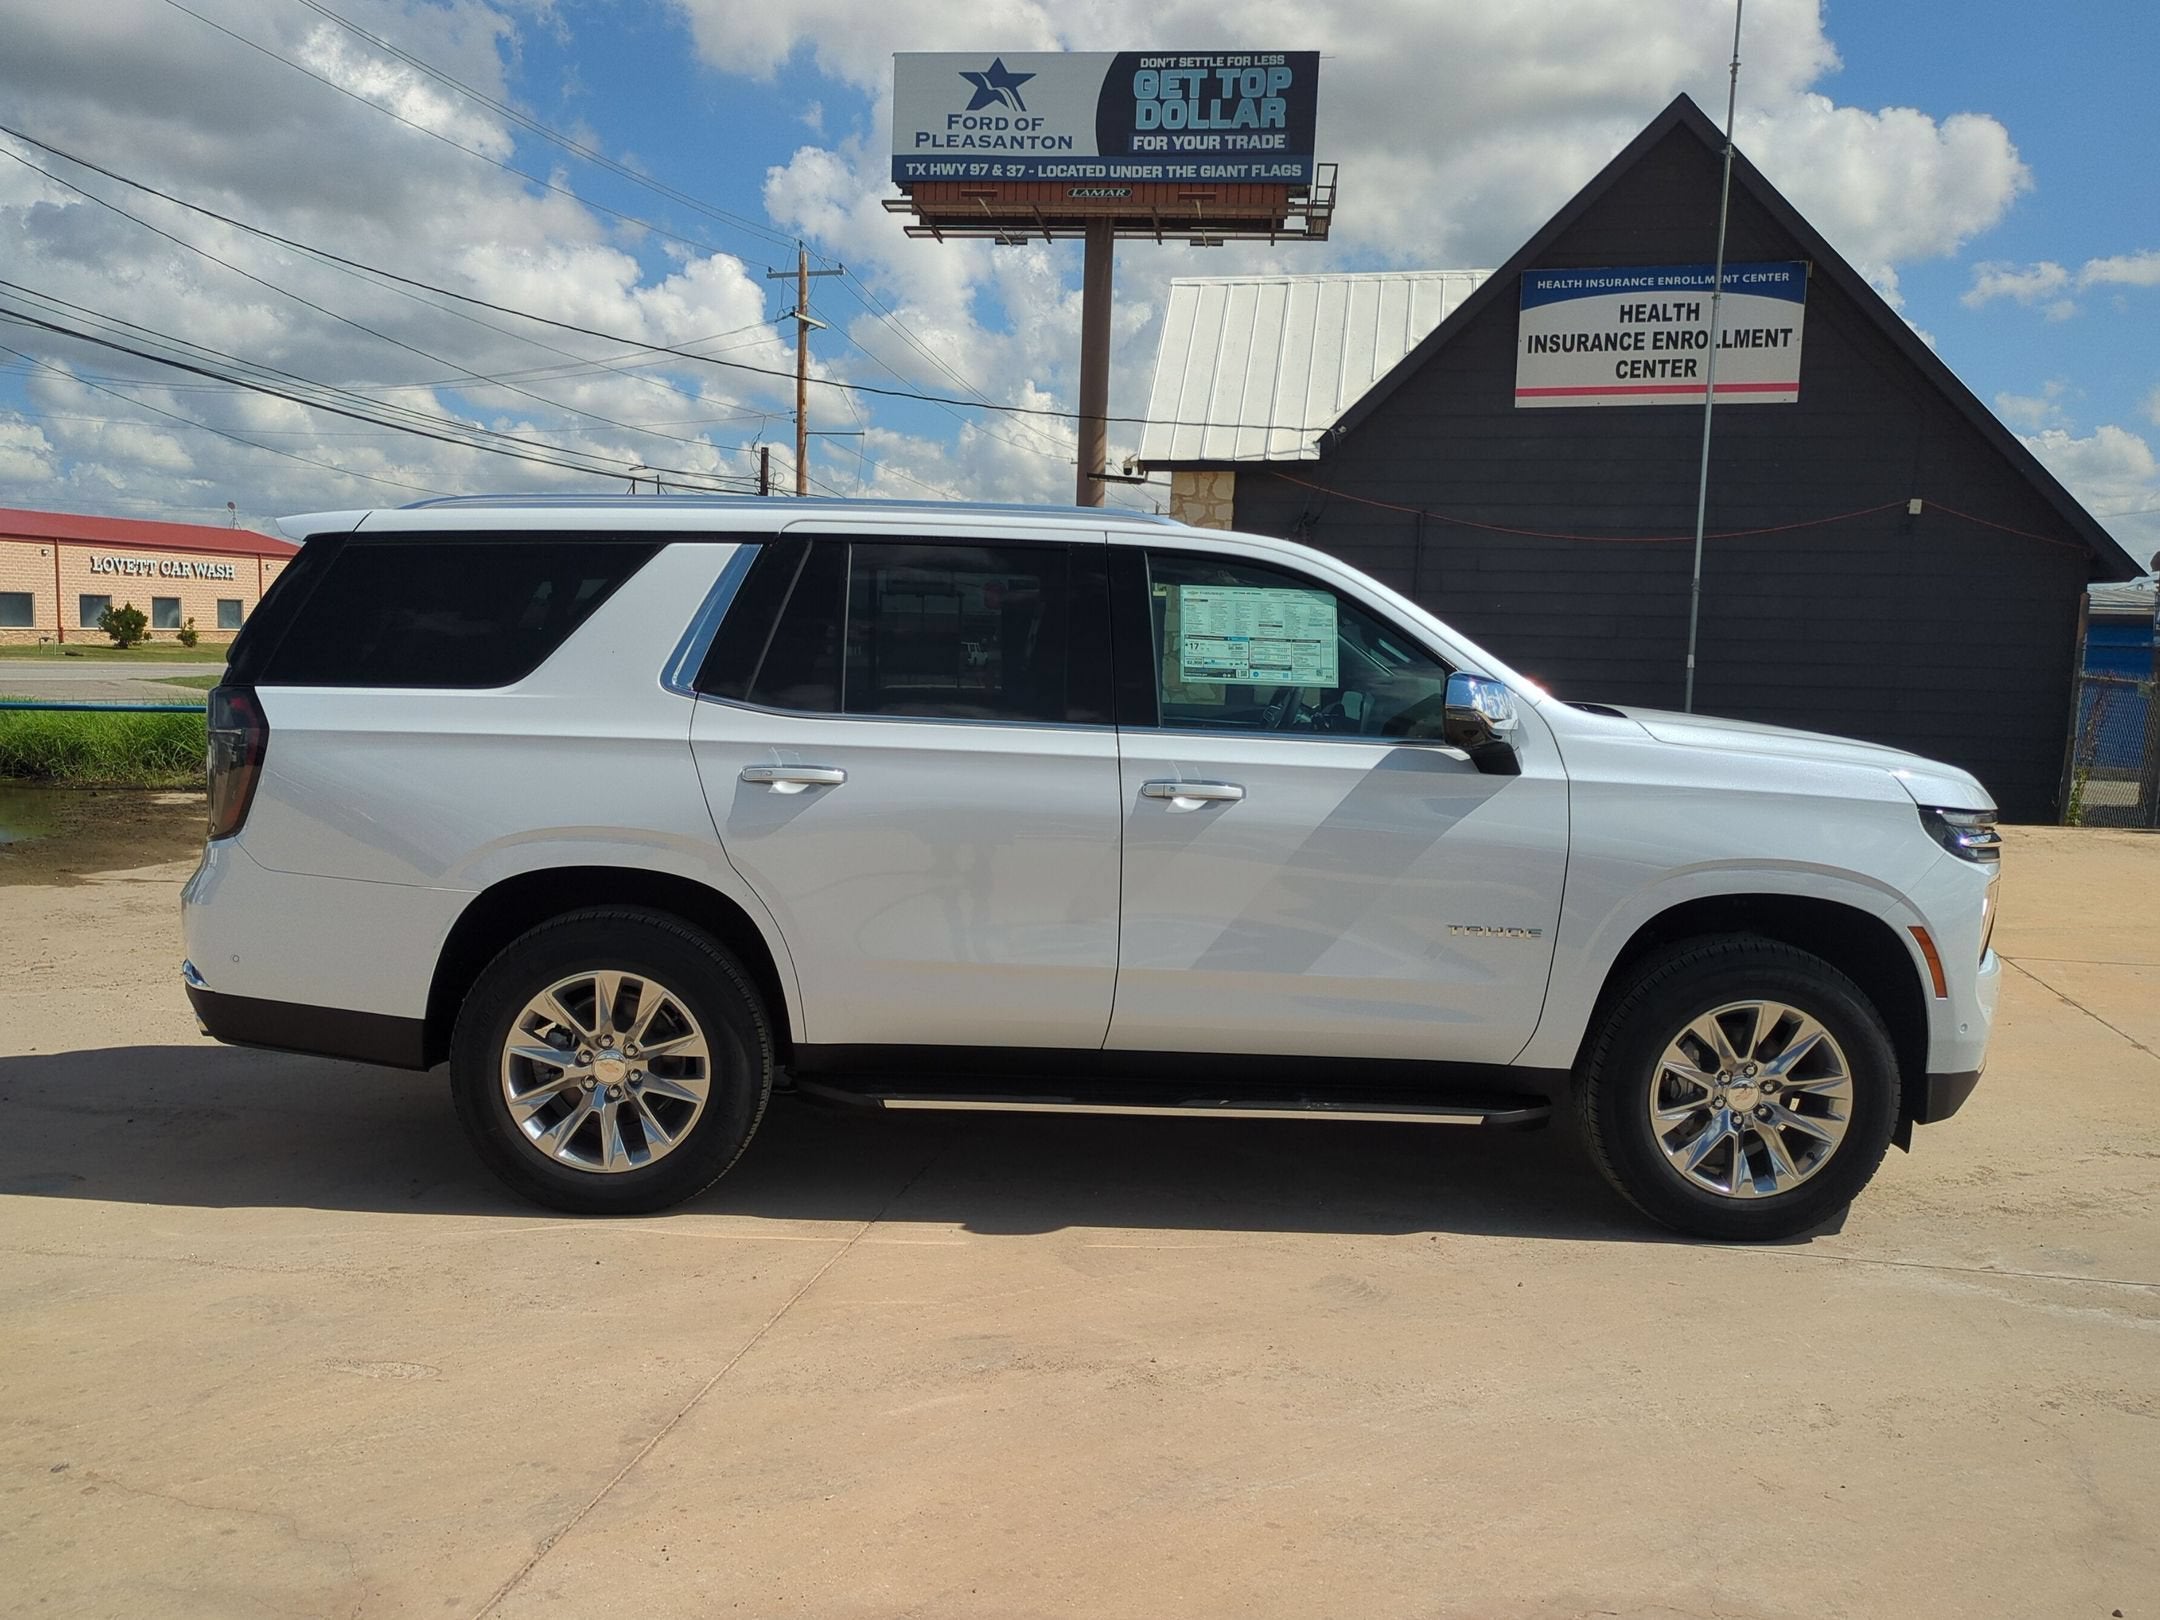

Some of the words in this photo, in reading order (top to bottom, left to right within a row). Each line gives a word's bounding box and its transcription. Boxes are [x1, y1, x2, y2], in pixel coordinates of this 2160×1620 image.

[1140, 57, 1177, 68] DON'T
[1179, 56, 1225, 67] SETTLE
[1227, 56, 1251, 66] FOR
[1254, 54, 1285, 66] LESS
[1133, 69, 1208, 100] GET
[1216, 66, 1293, 98] TOP
[947, 114, 1009, 131] FORD
[1014, 117, 1045, 131] OF
[1135, 98, 1287, 130] DOLLAR
[915, 132, 1073, 149] PLEASANTON
[1133, 136, 1168, 150] FOR
[1172, 136, 1221, 150] YOUR
[1225, 135, 1286, 149] TRADE
[906, 163, 926, 176] TX
[929, 163, 967, 176] HWY
[970, 164, 988, 176] 97
[992, 164, 1003, 177] &
[1006, 165, 1025, 177] 37
[1038, 165, 1106, 177] LOCATED
[1110, 165, 1162, 178] UNDER
[1166, 165, 1197, 178] THE
[1200, 165, 1248, 178] GIANT
[1251, 164, 1302, 177] FLAGS
[1072, 187, 1126, 198] LAMAR
[1537, 279, 1582, 289] HEALTH
[1585, 276, 1654, 288] INSURANCE
[1657, 274, 1739, 285] ENROLLMNT
[1742, 272, 1790, 283] CENTER
[1619, 302, 1700, 323] HEALTH
[1527, 332, 1645, 354] INSURANCE
[1615, 358, 1697, 379] CENTER
[91, 556, 157, 575] LOVETT
[160, 560, 192, 578] CAR
[193, 562, 236, 580] WASH
[1190, 642, 1200, 650] 17
[1447, 924, 1543, 938] TAHOE
